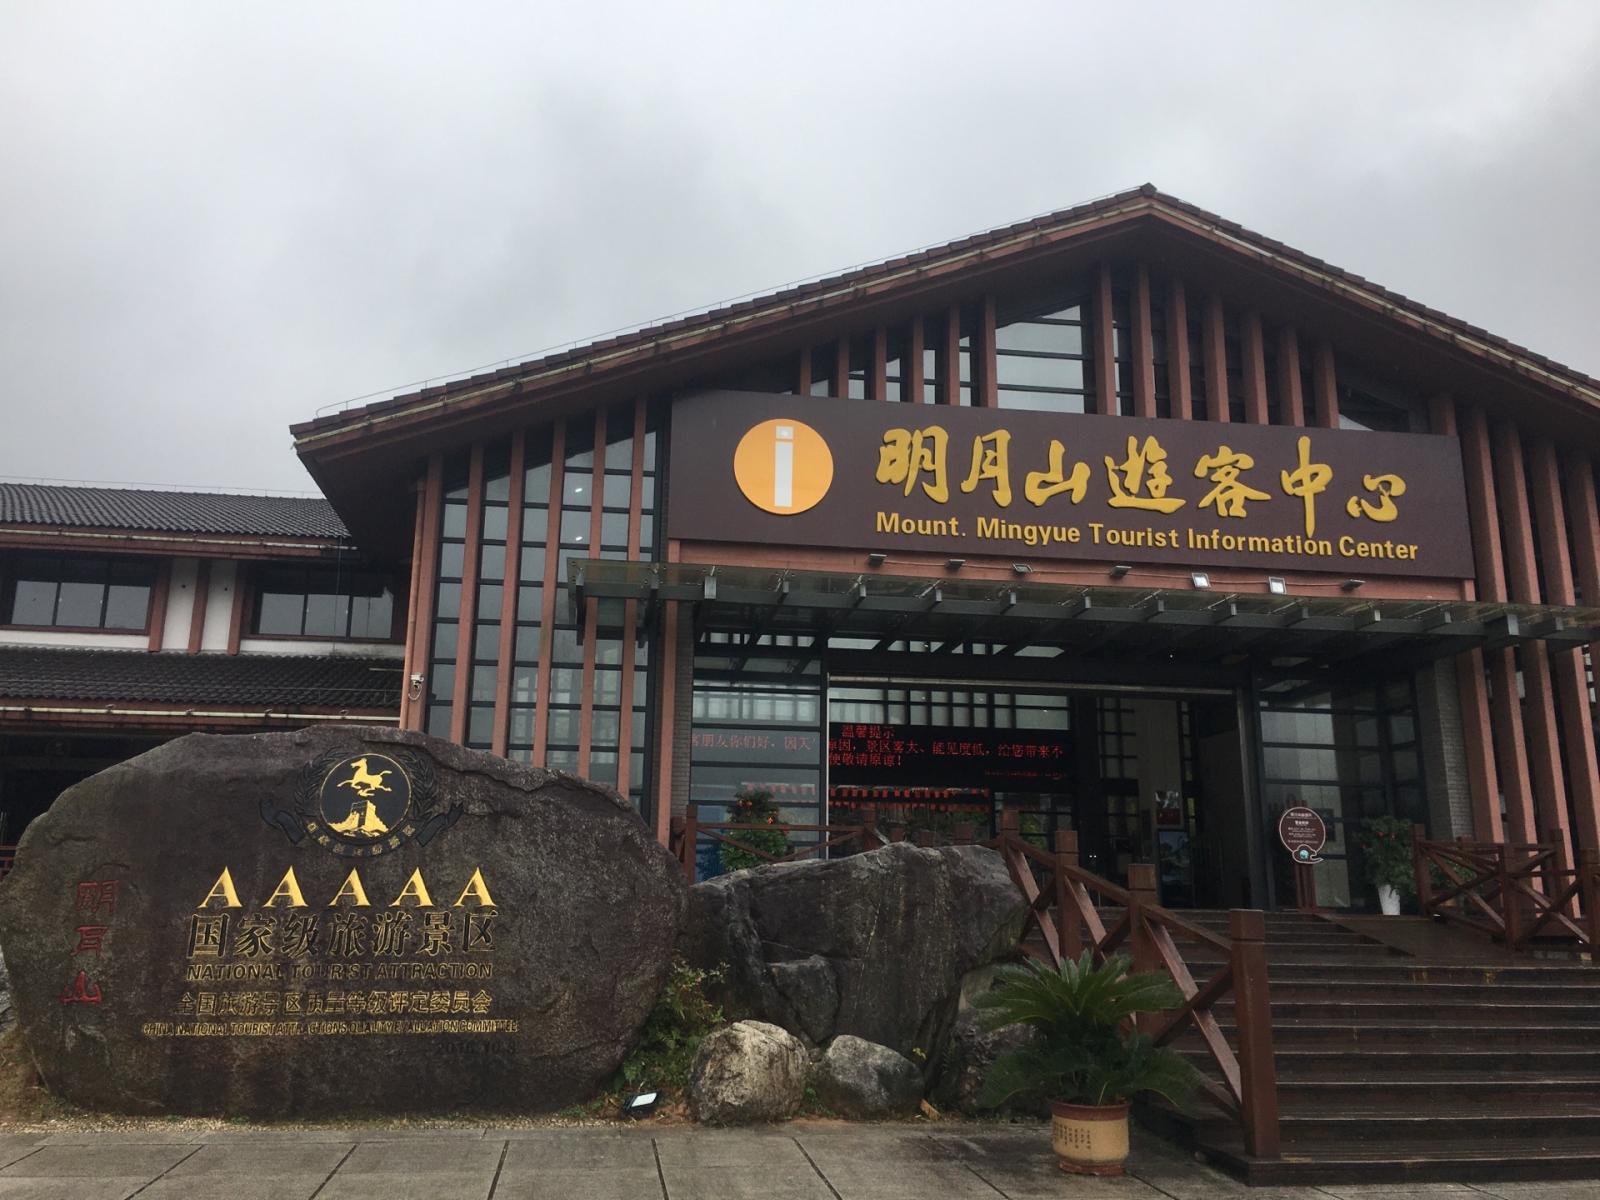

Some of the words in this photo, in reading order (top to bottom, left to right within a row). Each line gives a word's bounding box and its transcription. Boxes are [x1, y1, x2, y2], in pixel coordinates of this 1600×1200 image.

[876, 511, 966, 537] Mount.
[977, 516, 1081, 546] Mingyue
[1088, 522, 1179, 548] Tourist
[1188, 528, 1332, 556] Information
[1339, 536, 1418, 560] Center
[186, 910, 499, 958] 国家级旅游景区
[186, 964, 285, 981] NATIONAL
[292, 963, 372, 980] TOURIST
[375, 962, 493, 980] ATTRACTION
[143, 1021, 173, 1036] CHINA
